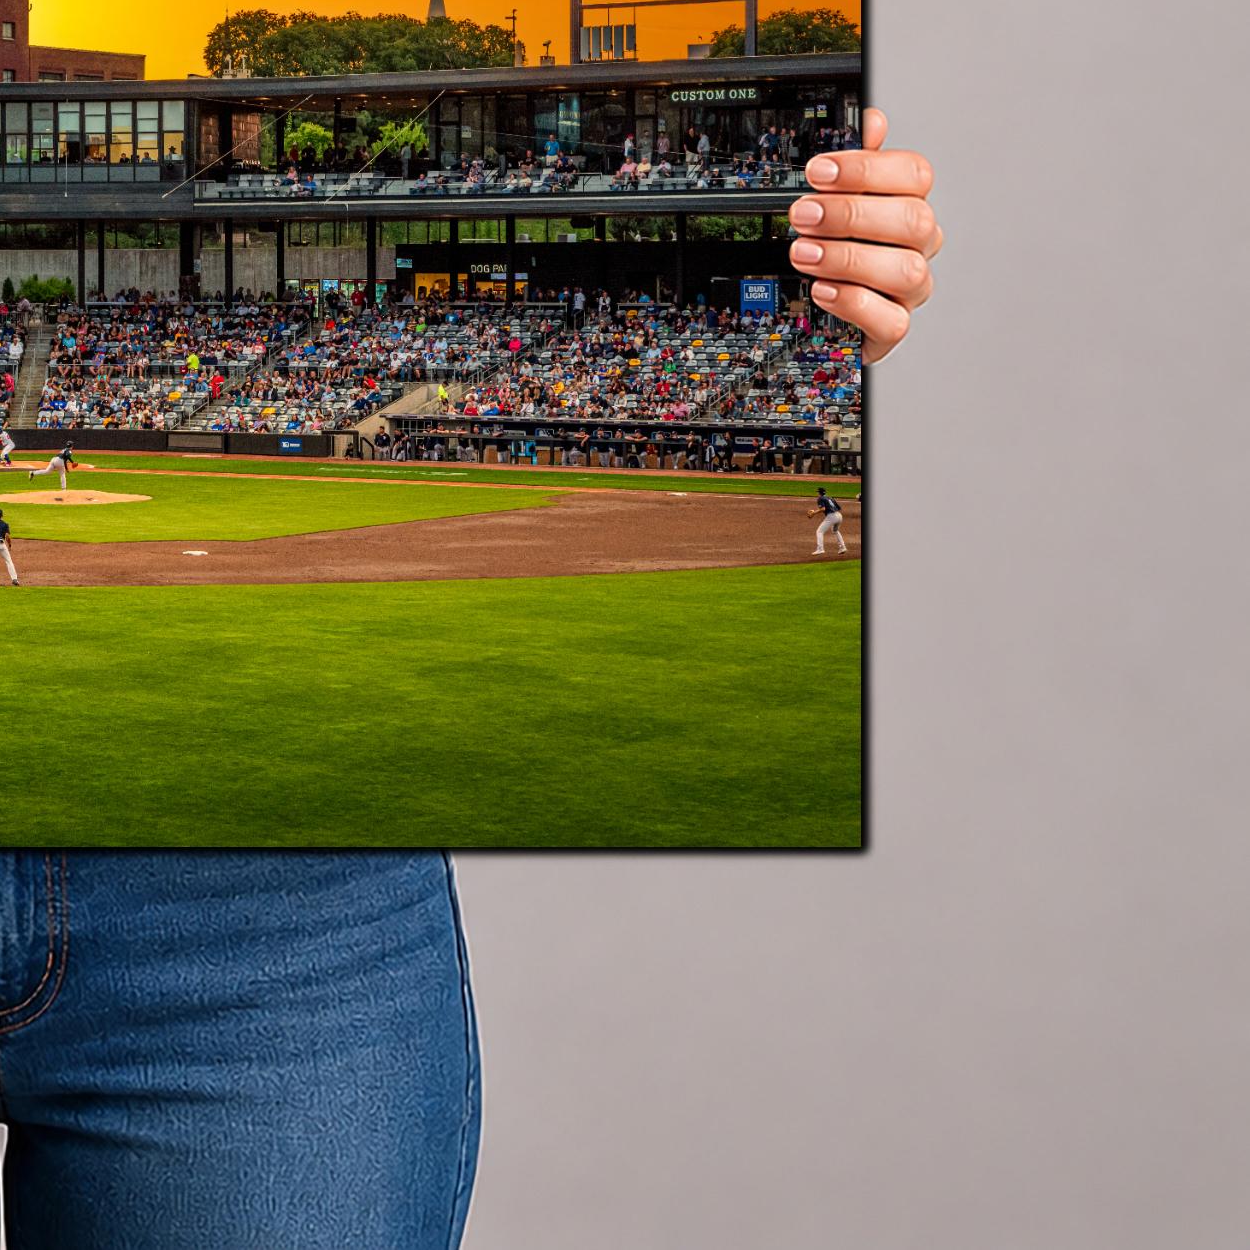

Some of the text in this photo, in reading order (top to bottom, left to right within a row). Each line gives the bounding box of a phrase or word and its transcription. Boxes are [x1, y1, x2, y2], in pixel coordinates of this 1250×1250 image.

[671, 88, 757, 102] CUSTOM ONE
[470, 264, 490, 273] DOG
[748, 285, 766, 293] BUD
